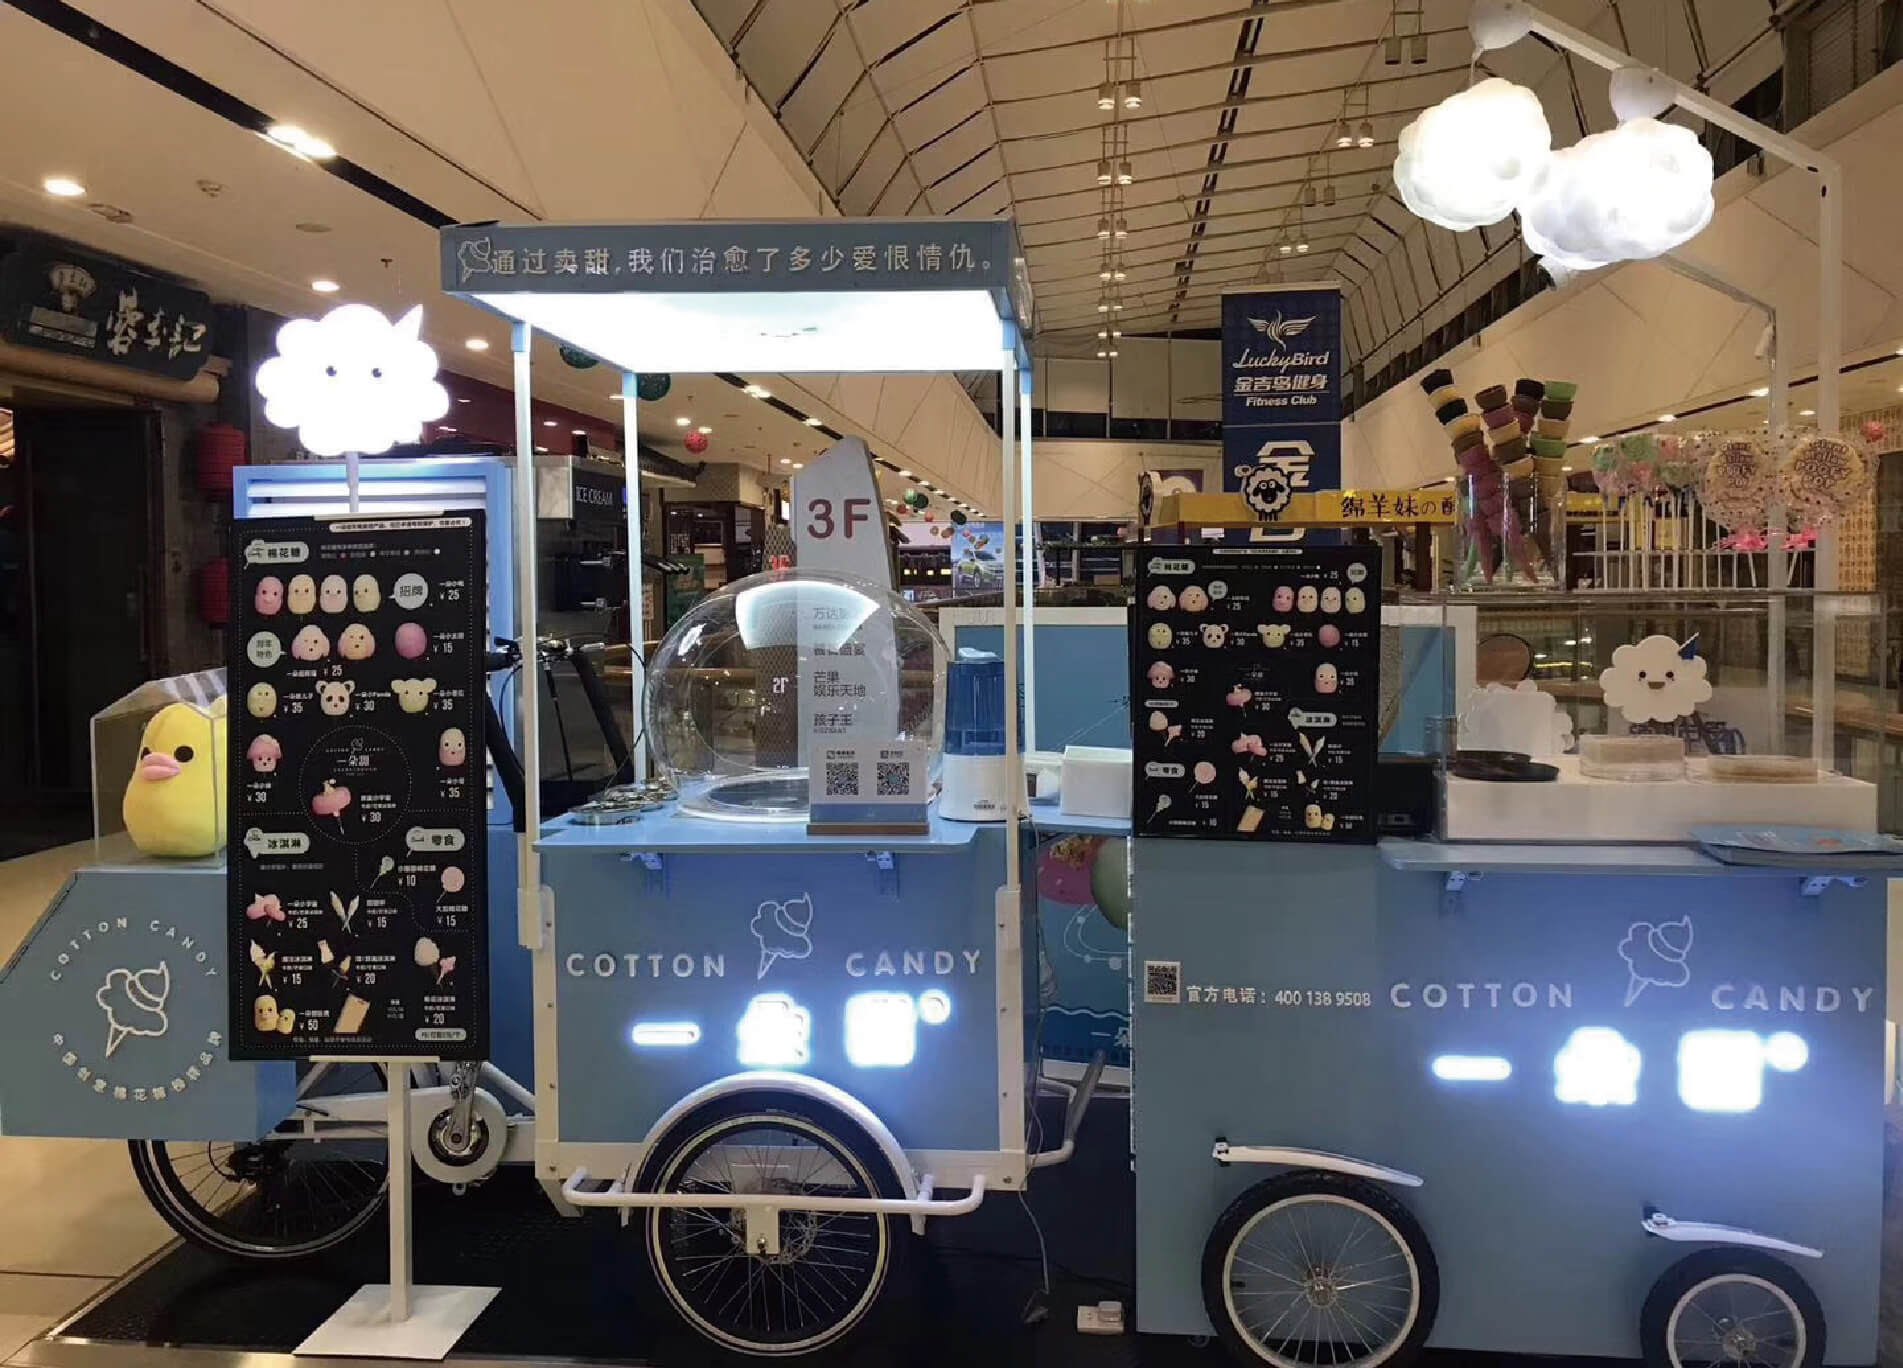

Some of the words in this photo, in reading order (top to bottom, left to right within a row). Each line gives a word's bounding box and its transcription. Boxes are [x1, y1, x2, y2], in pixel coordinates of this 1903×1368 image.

[1232, 348, 1330, 374] LuckyBird
[1245, 396, 1288, 407] Fitness
[1291, 395, 1318, 406] Club
[807, 499, 872, 540] 3F
[448, 589, 460, 600] 25
[443, 642, 453, 654] 15
[331, 665, 343, 676] 25
[448, 787, 460, 798] 35
[406, 874, 417, 887] 10
[296, 917, 309, 929] 25
[376, 917, 387, 928] 15
[446, 914, 457, 927] 15
[50, 917, 128, 981] COTTON
[150, 919, 217, 977] CANDY
[566, 953, 725, 978] COTTON
[846, 949, 982, 977] CANDY
[291, 973, 302, 985] 15
[365, 972, 377, 985] 20
[1274, 990, 1303, 1006] 400
[1307, 990, 1332, 1006] 138
[1335, 991, 1371, 1007] 9508
[1389, 982, 1573, 1009] COTTON
[1710, 985, 1875, 1014] CANDY
